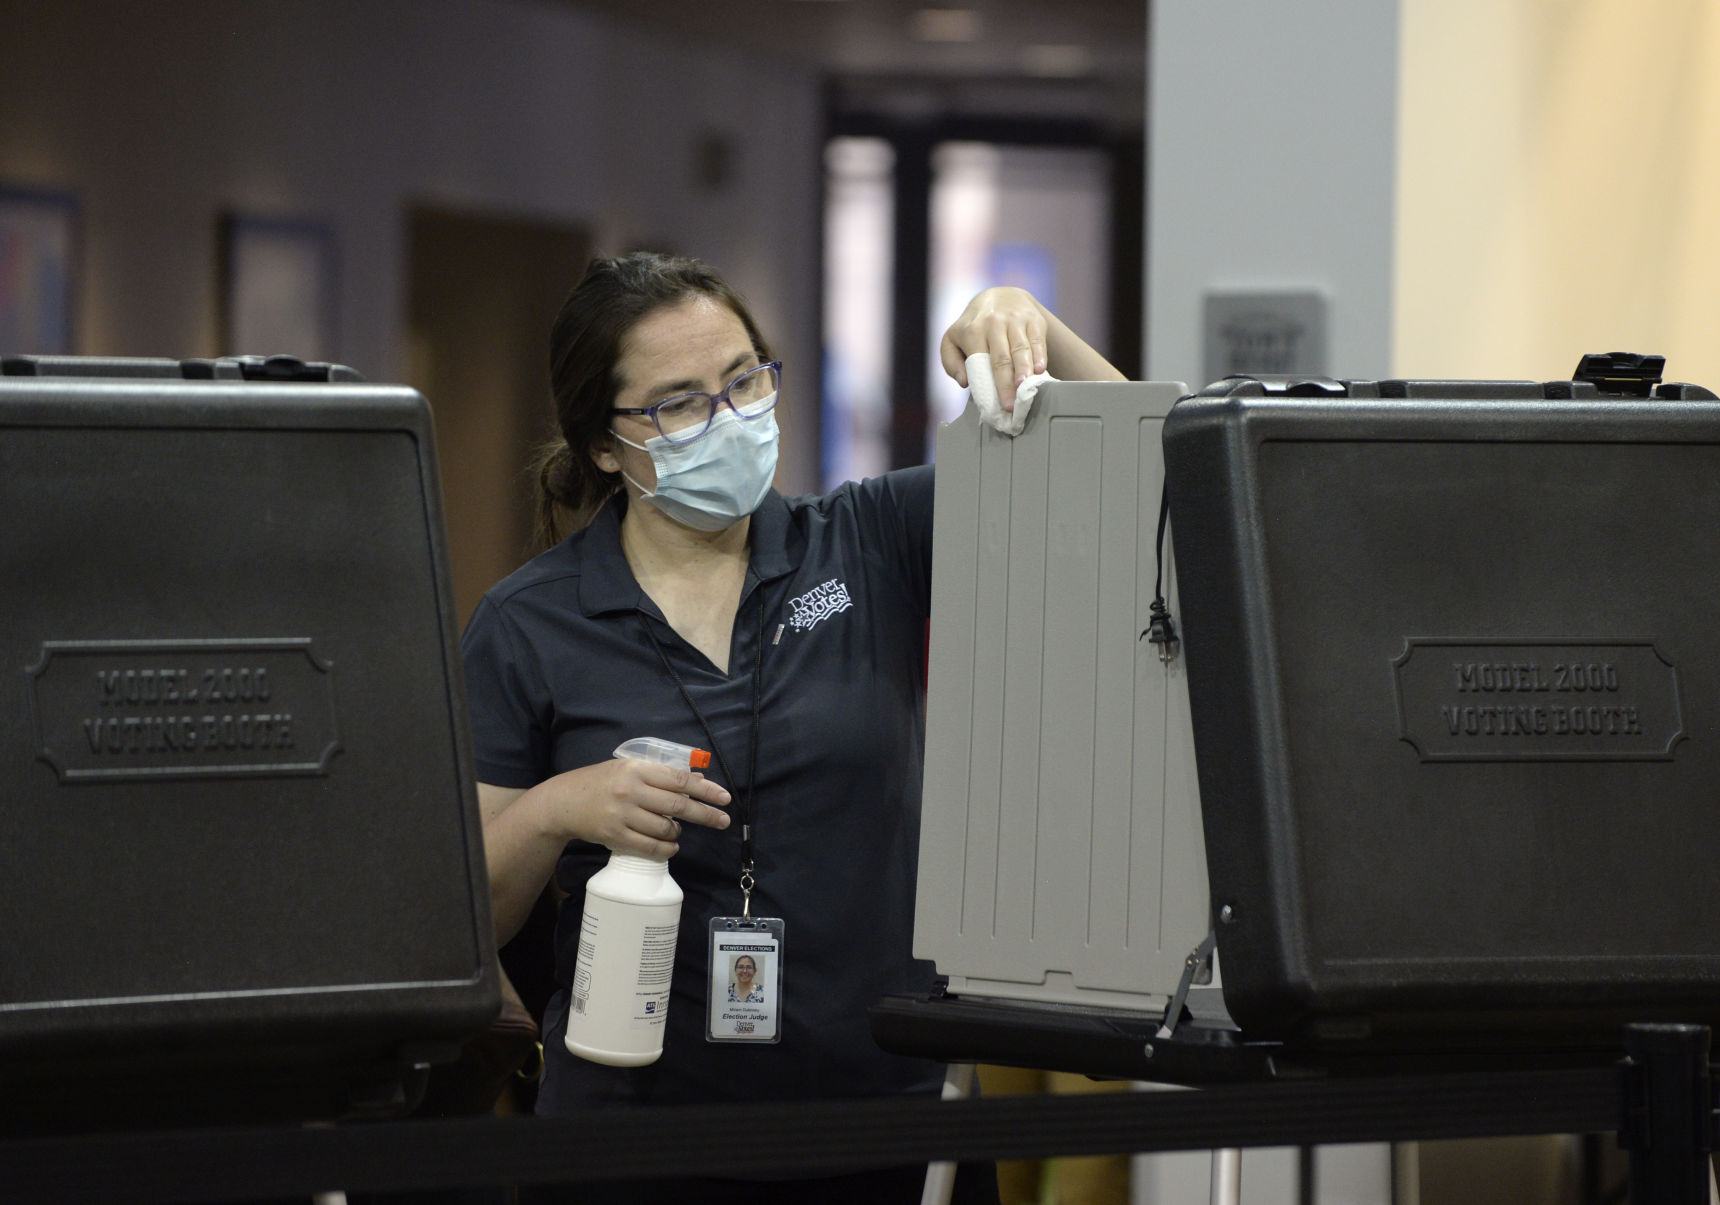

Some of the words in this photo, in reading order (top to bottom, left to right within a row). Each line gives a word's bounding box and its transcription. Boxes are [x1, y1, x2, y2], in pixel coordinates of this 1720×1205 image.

[788, 578, 838, 613] Denver
[800, 583, 851, 616] Votes!
[97, 668, 198, 704] MODEL
[202, 667, 269, 701] 2000
[1453, 662, 1551, 693] MODEL
[1553, 662, 1620, 692] 2000
[83, 716, 198, 753] VOTING
[202, 713, 294, 750] BOOTH
[1442, 705, 1549, 736] VOTING
[1551, 705, 1643, 735] BOOTH
[749, 1013, 768, 1021] Judge
